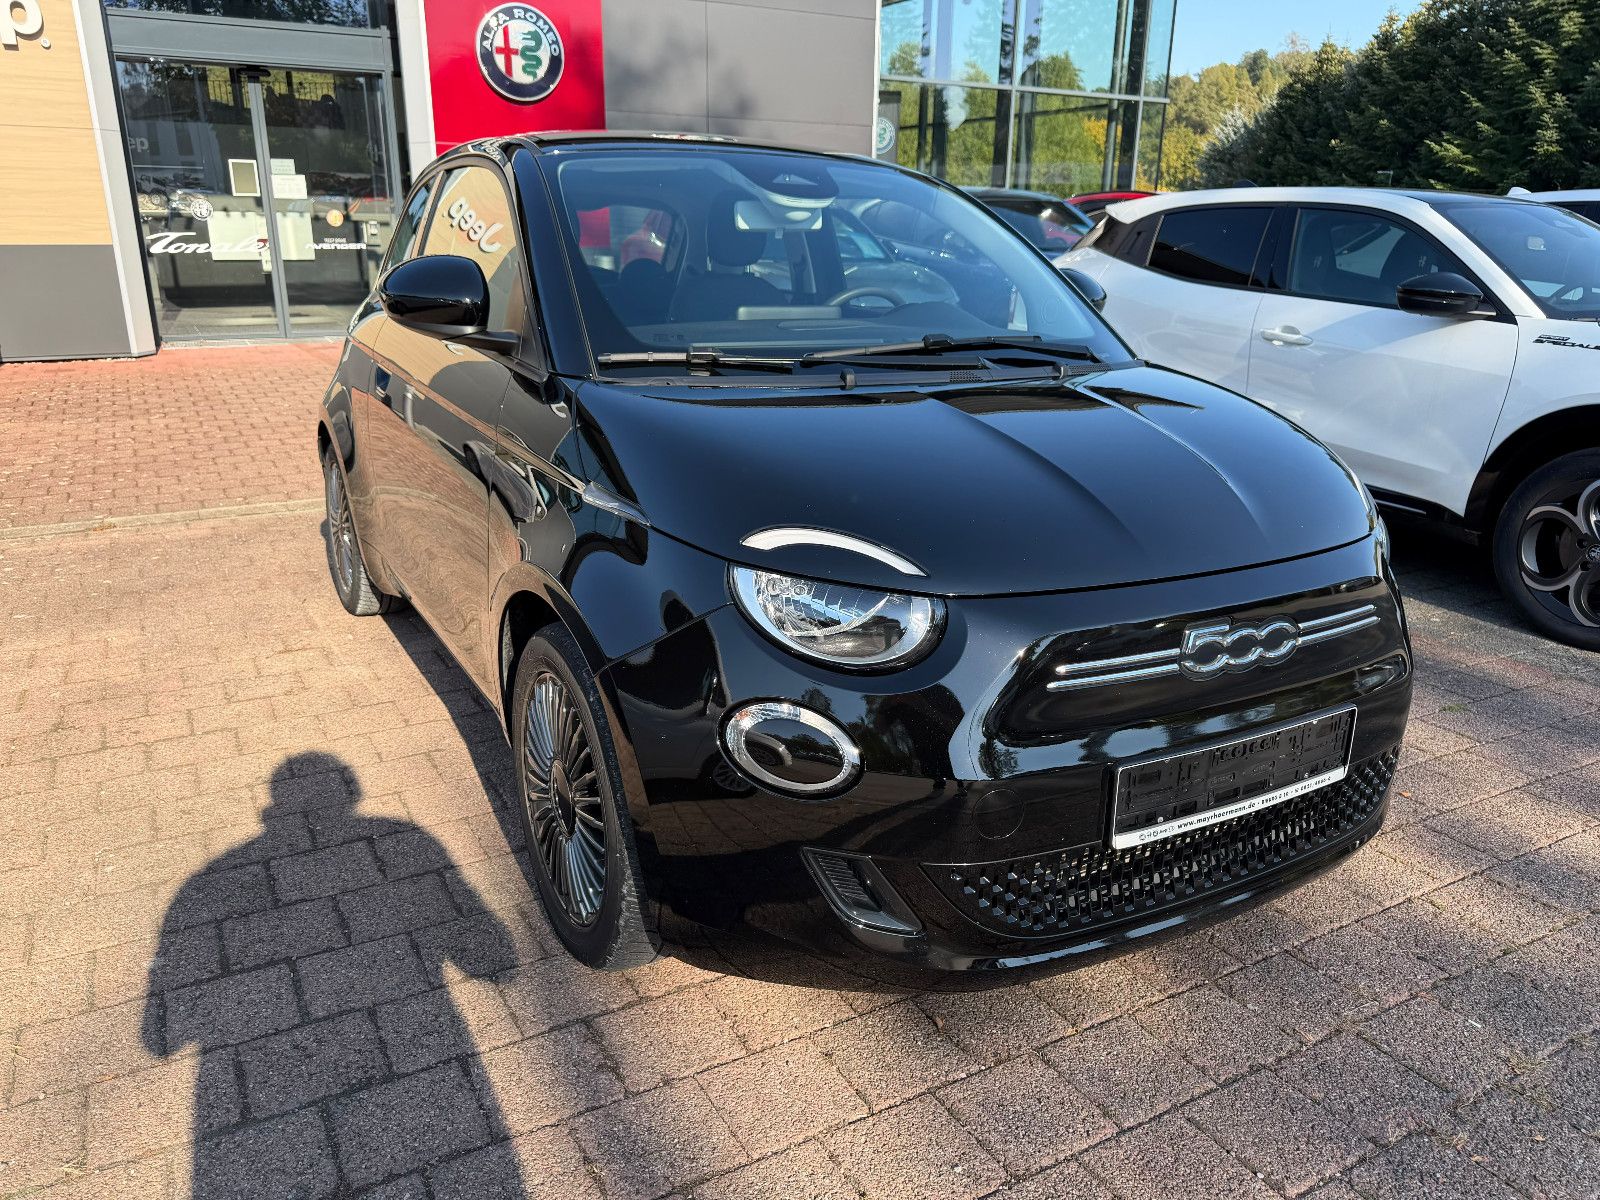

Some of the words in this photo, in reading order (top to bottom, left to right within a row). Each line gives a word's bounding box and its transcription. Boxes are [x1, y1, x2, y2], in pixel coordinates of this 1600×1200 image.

[482, 12, 510, 51] ALFA
[513, 8, 560, 57] ROMEO
[145, 231, 267, 254] Tonale
[1181, 622, 1299, 674] 500
